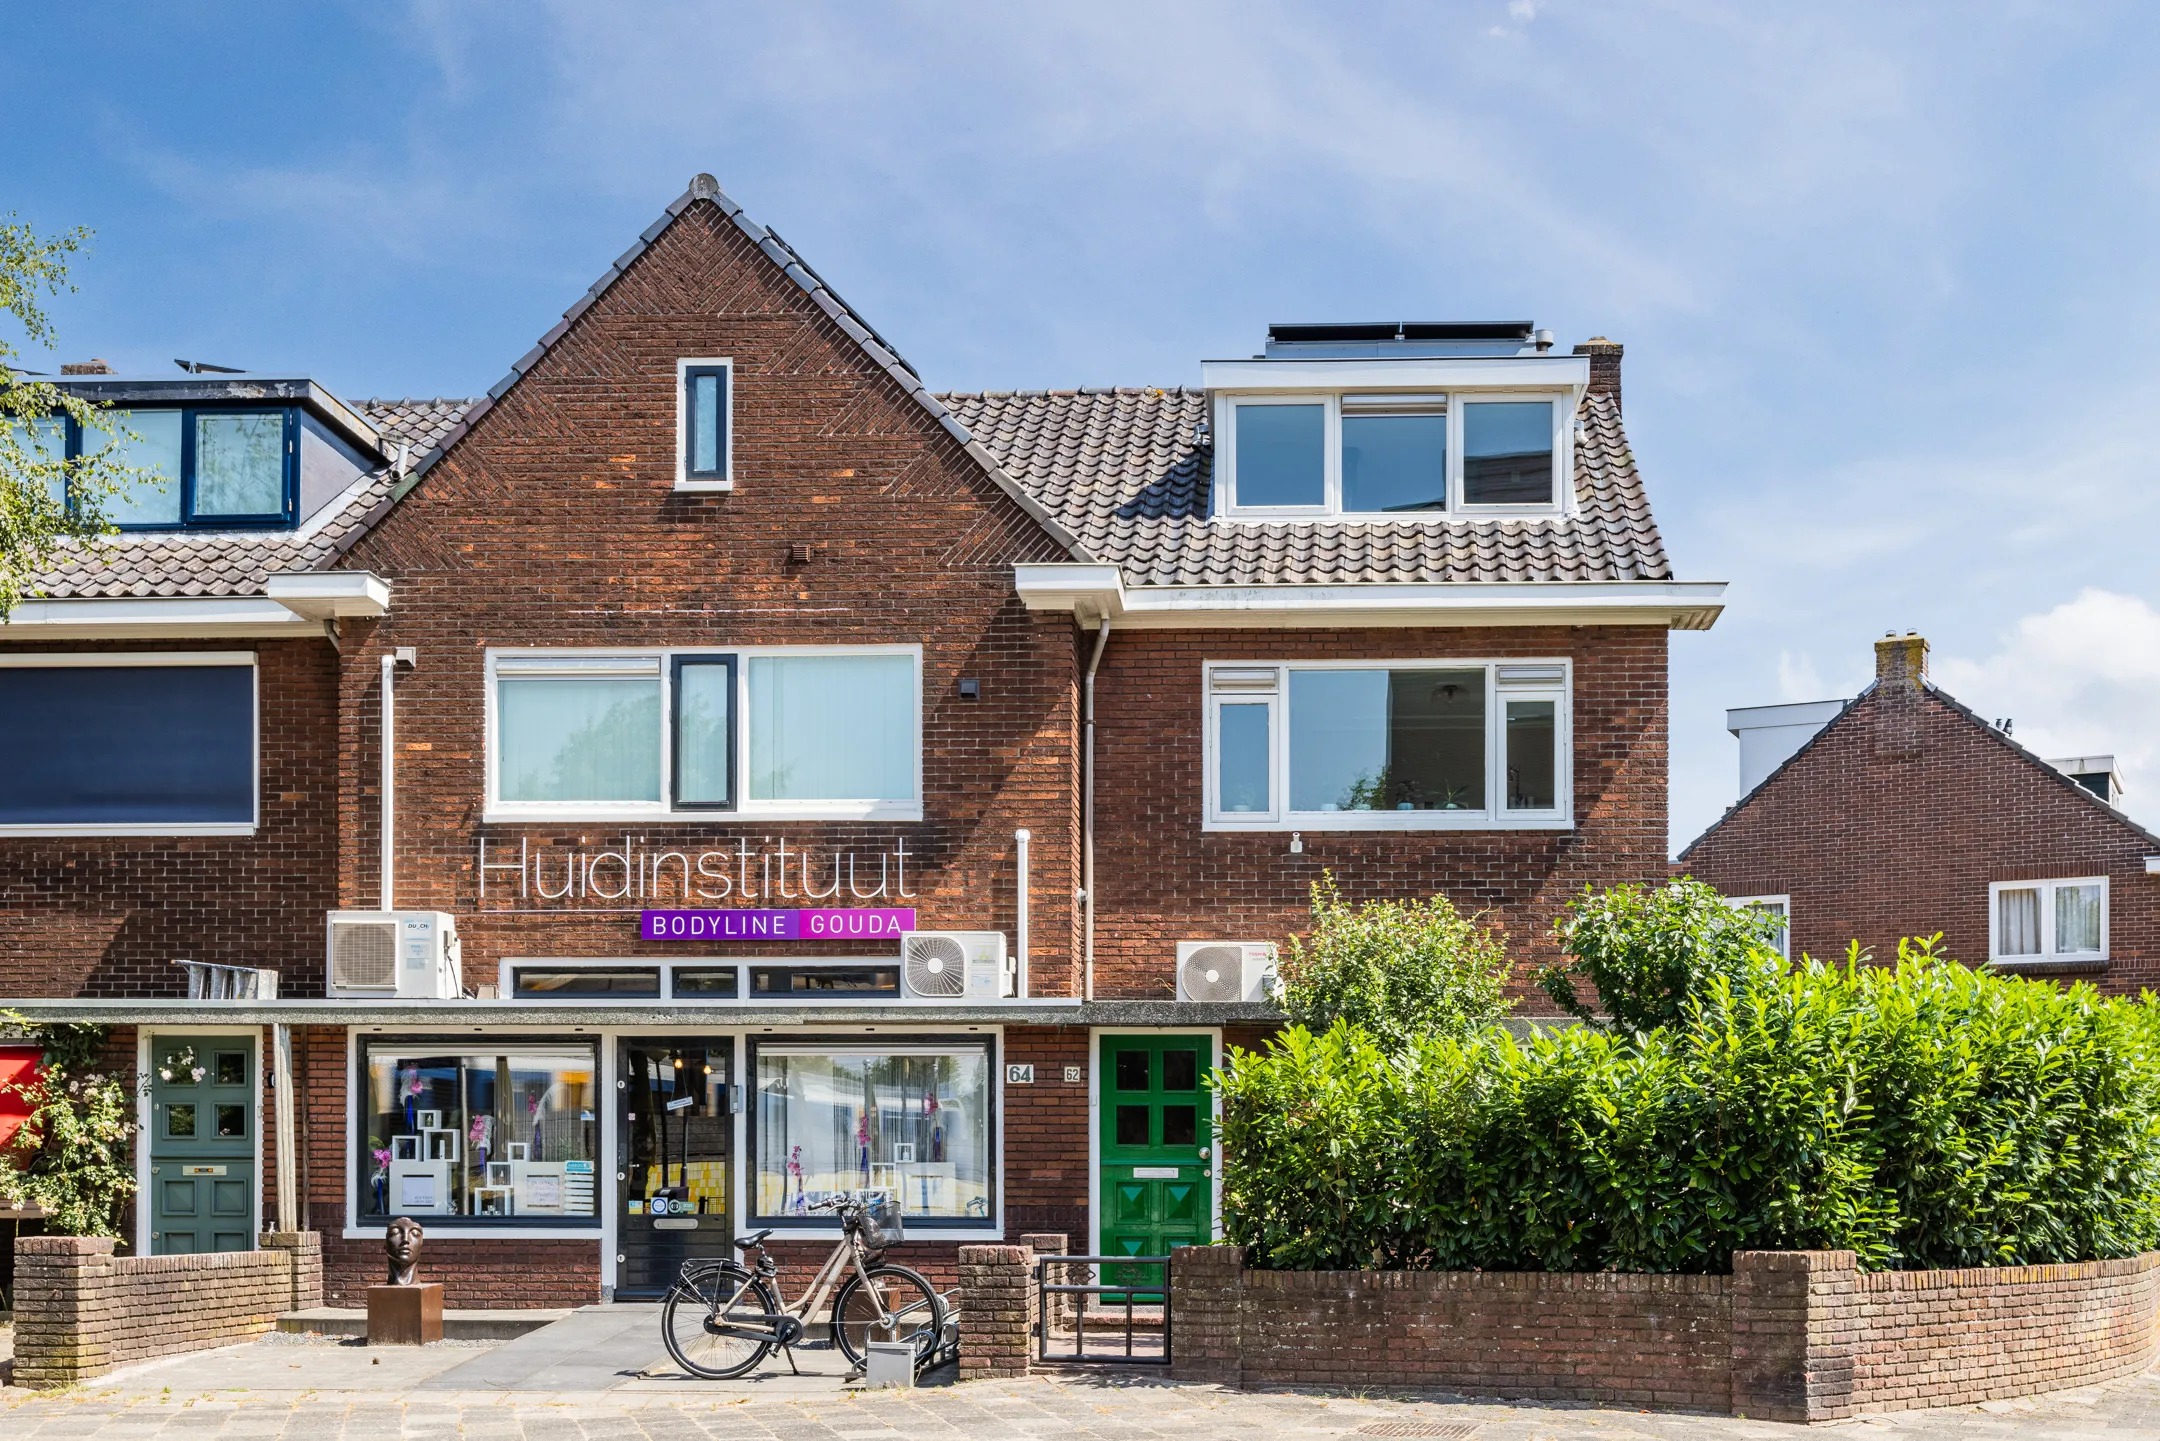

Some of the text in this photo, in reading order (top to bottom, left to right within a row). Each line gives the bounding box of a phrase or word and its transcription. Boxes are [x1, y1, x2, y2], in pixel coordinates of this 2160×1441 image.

[480, 835, 917, 899] Huidinstituut
[653, 915, 901, 935] BODYLINE GOUDA
[1009, 1065, 1031, 1082] 64
[1066, 1068, 1079, 1080] 62
